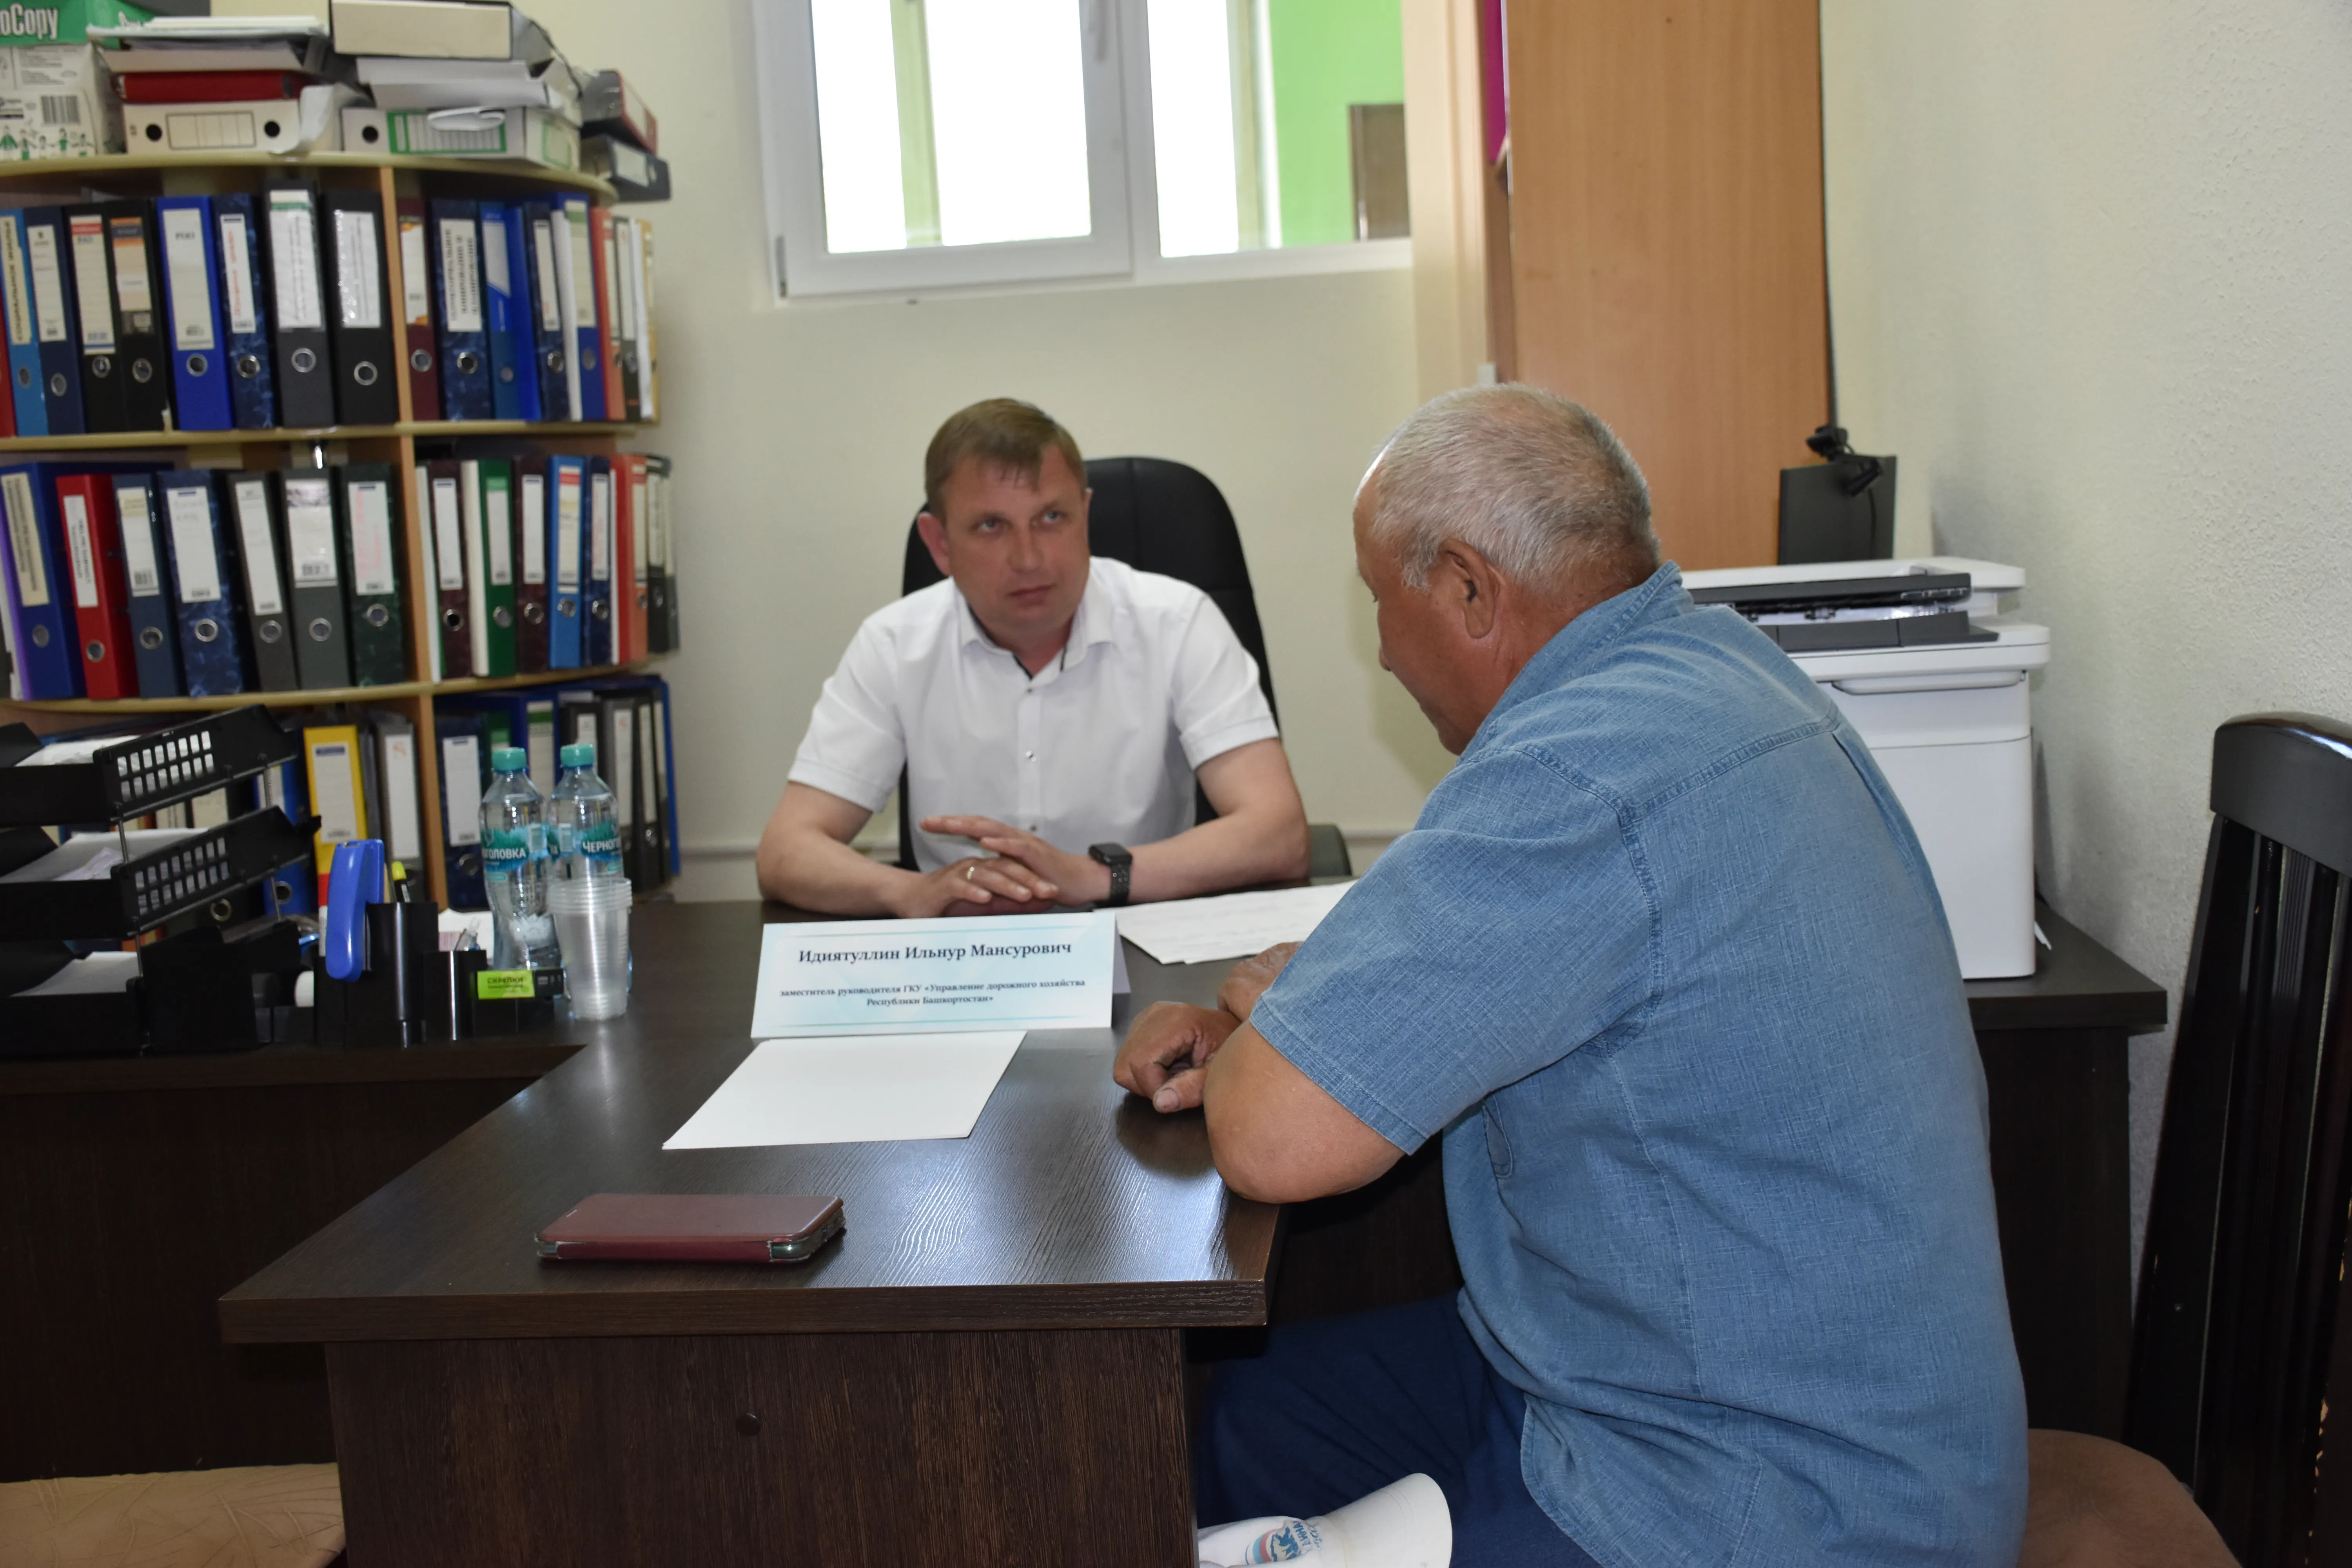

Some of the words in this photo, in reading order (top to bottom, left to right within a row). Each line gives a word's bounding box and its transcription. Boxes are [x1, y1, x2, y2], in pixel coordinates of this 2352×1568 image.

[799, 949, 900, 964] Идиятуллин
[905, 946, 966, 961] Ильнур
[971, 943, 1072, 958] Мансурович
[779, 988, 835, 996] заместитель
[838, 986, 901, 997] руководителя
[903, 985, 922, 993] ГКУ
[924, 983, 985, 993] «Управление
[986, 982, 1037, 991] дорожного
[1039, 978, 1086, 987] хозяйства
[867, 997, 920, 1007] Республики
[922, 995, 994, 1005] Башкортостан»
